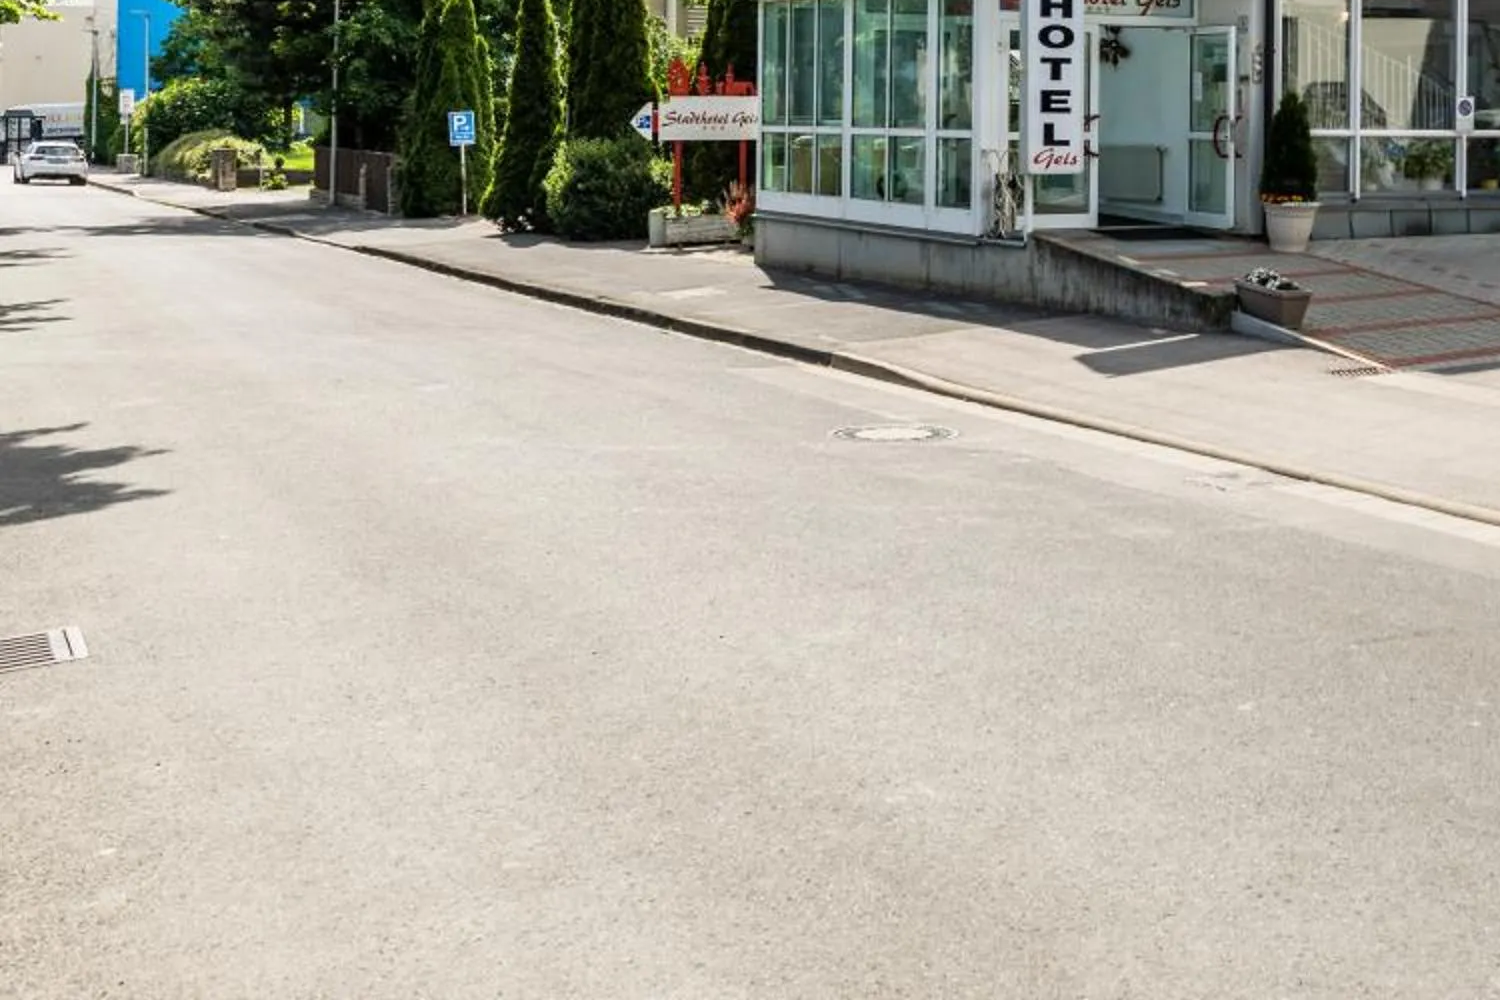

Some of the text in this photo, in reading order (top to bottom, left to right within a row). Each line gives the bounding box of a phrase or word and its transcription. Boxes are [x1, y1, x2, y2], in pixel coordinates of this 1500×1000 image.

[453, 115, 467, 131] P
[662, 110, 729, 126] Stadthotel
[1033, 148, 1078, 170] Geis
